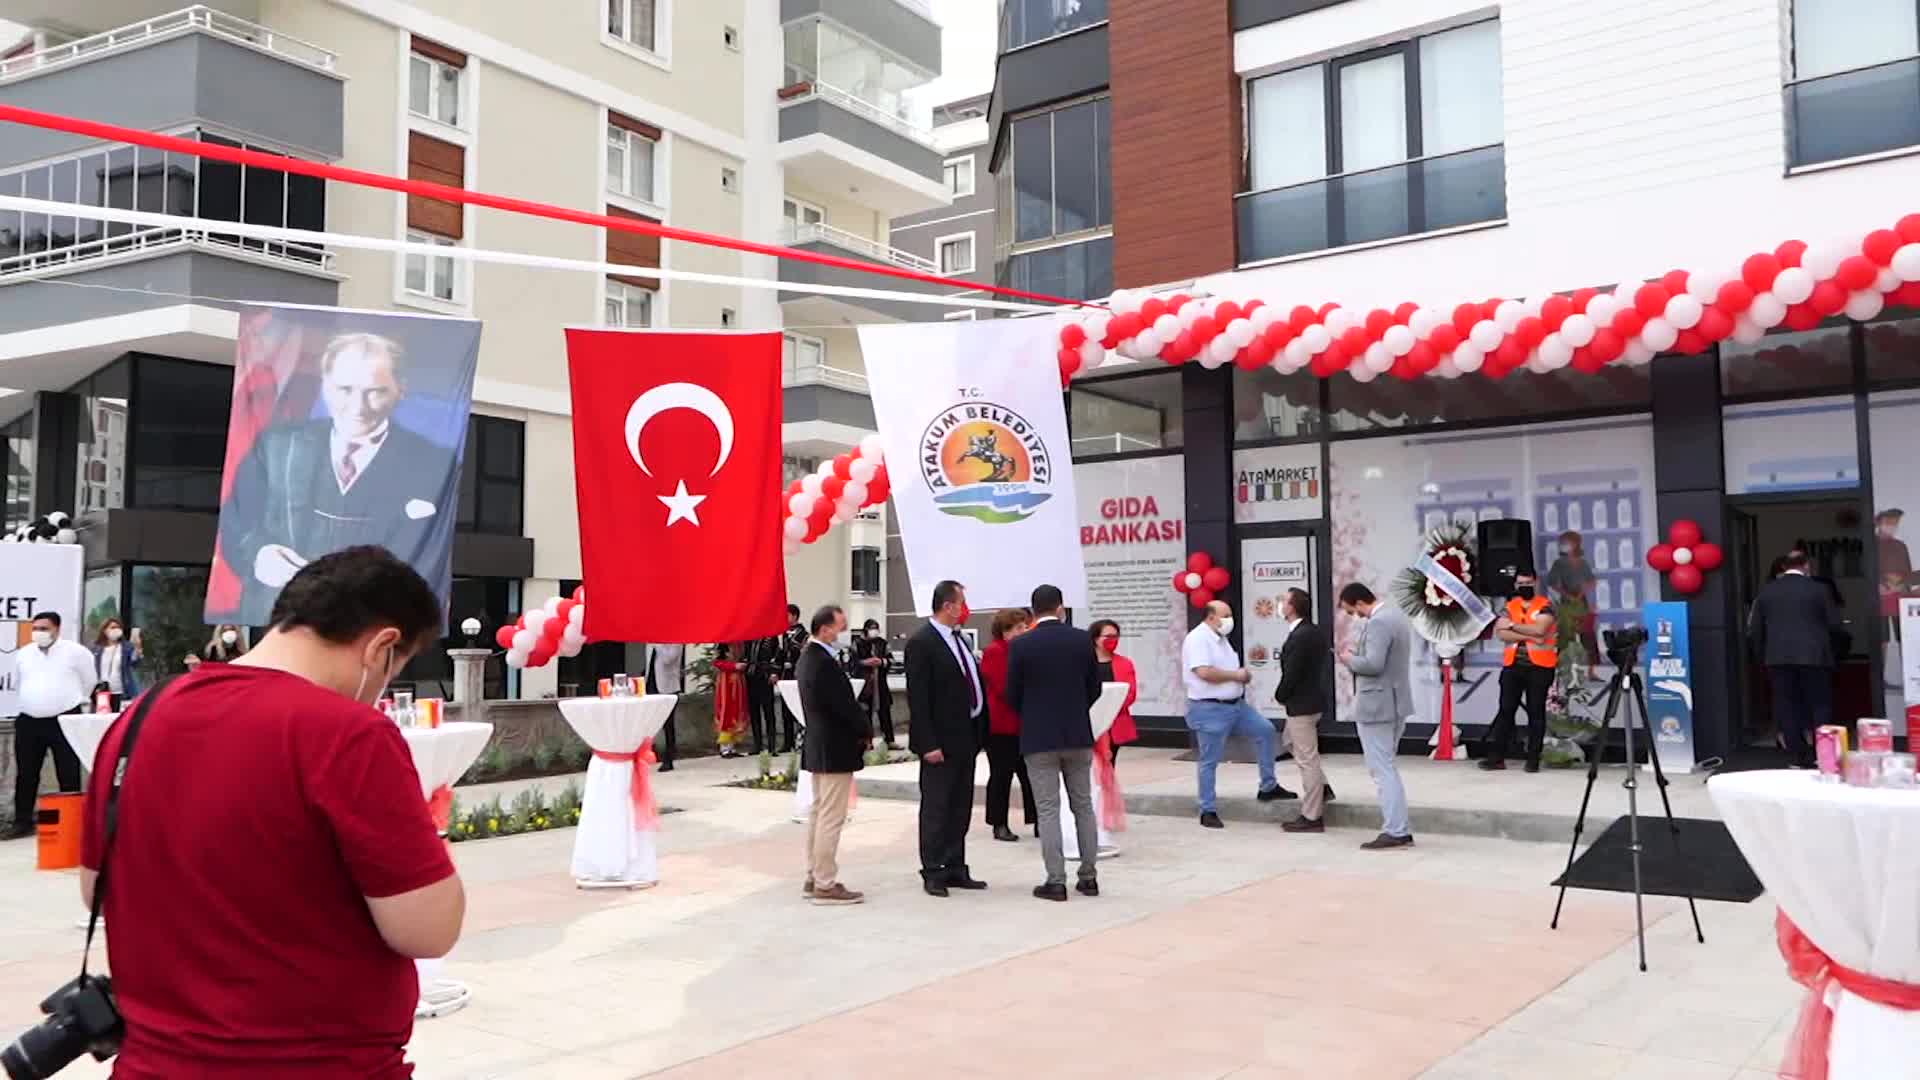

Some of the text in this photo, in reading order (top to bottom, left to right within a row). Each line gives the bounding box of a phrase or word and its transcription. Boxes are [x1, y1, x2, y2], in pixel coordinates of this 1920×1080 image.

[924, 413, 960, 488] ATAKUM
[1100, 495, 1159, 520] GIDA
[1080, 519, 1183, 546] BANKASI
